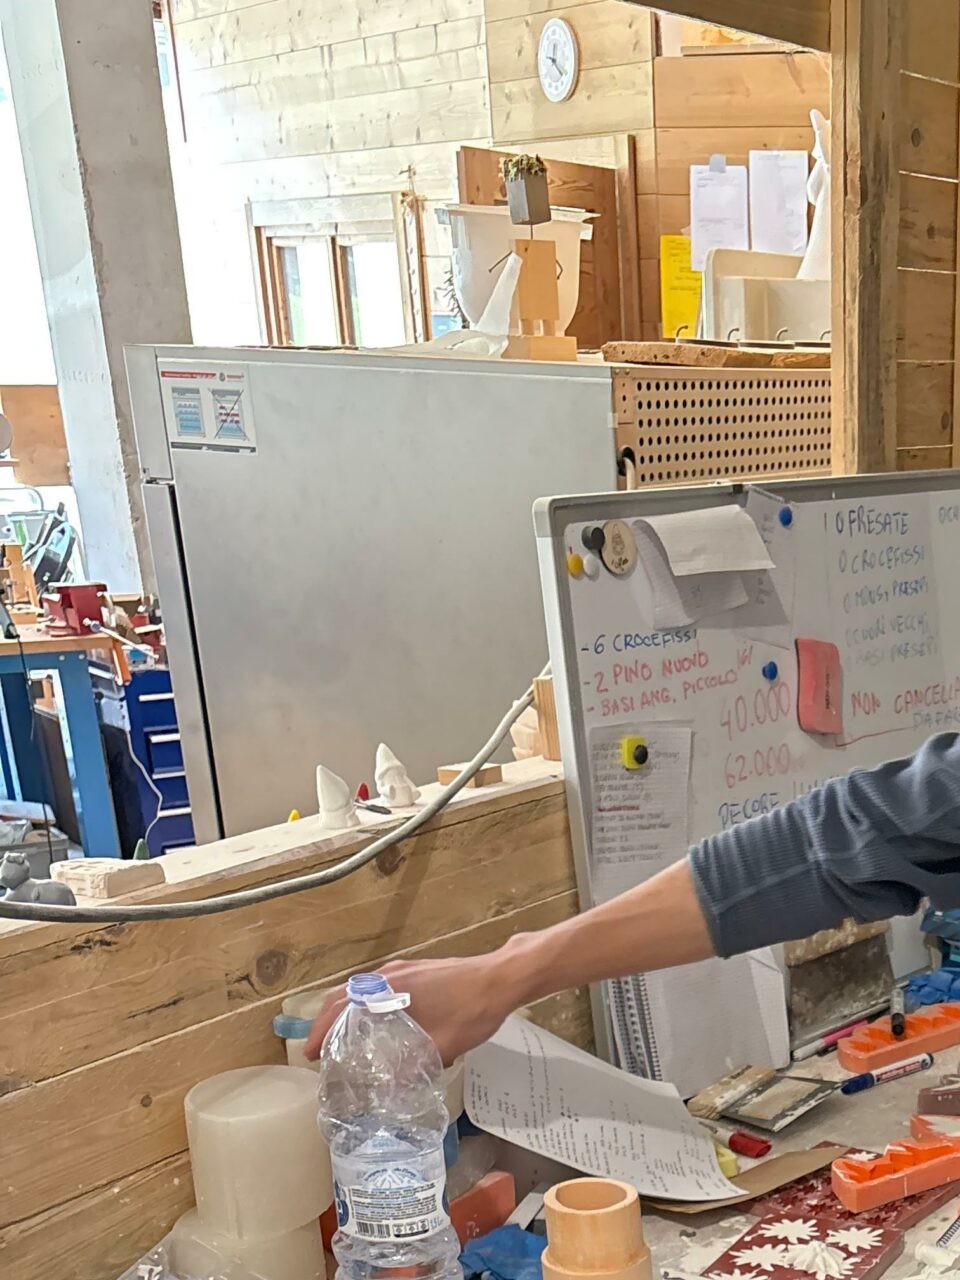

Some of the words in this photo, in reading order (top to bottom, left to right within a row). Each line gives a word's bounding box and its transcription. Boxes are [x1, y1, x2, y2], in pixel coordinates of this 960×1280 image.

[848, 505, 909, 538] FRESATE
[851, 545, 925, 574] CROCEFISSI
[613, 629, 697, 652] CROCEFISSI
[594, 672, 608, 693] 2
[613, 659, 652, 685] PINO
[662, 651, 709, 677] NUOVO
[600, 697, 635, 716] BASI
[683, 669, 738, 699] PICCOLO
[720, 681, 791, 742] 40.000
[725, 743, 790, 789] 62.000
